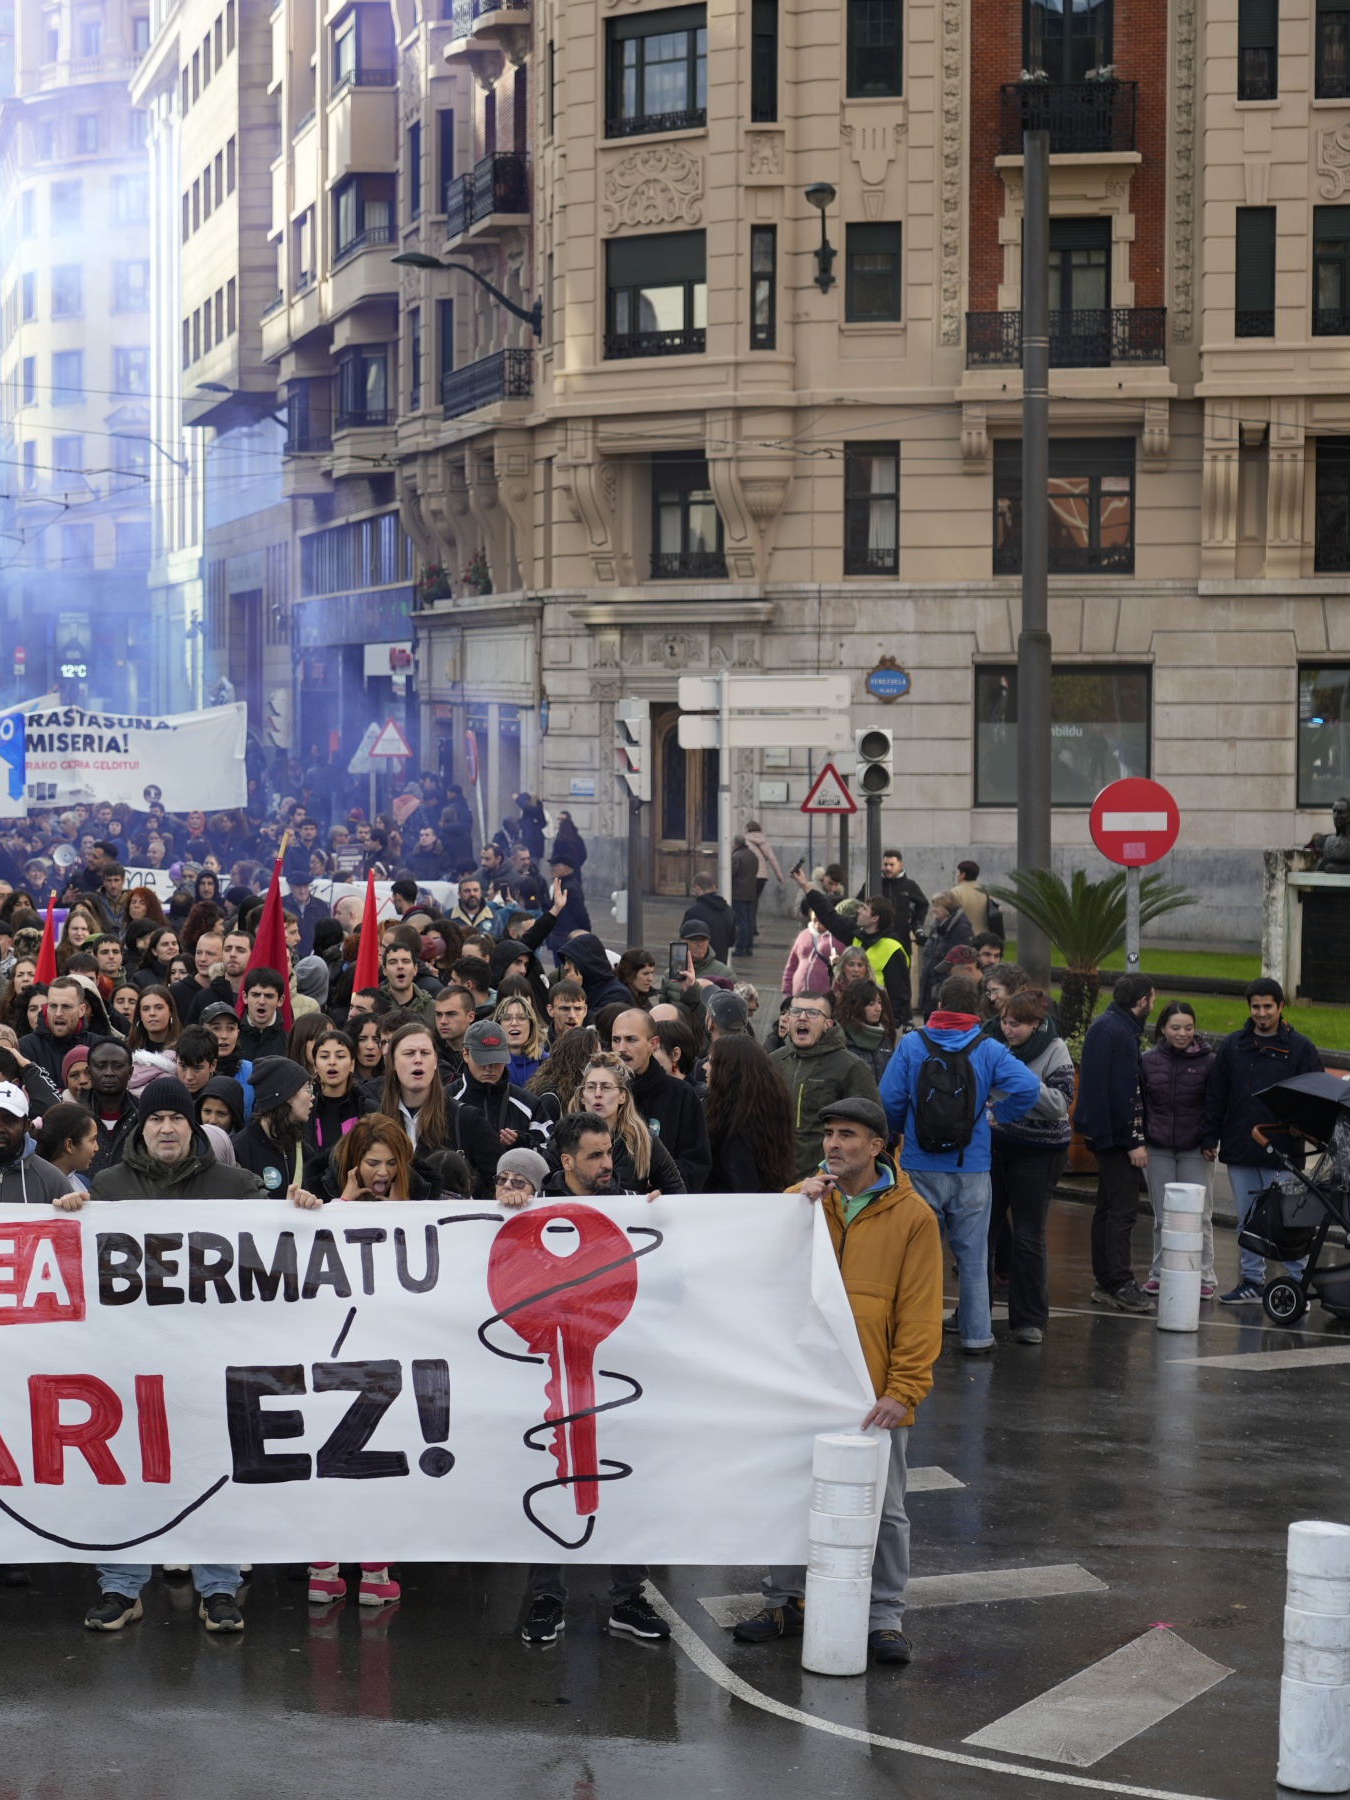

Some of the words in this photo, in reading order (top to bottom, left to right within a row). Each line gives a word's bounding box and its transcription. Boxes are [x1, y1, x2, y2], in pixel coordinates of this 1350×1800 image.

[870, 678, 907, 686] VENEZUELA
[20, 707, 179, 732] RASTASUNA,
[1051, 725, 1083, 738] bildu
[26, 734, 129, 753] MISERIA!
[25, 760, 57, 770] RAKO
[93, 760, 140, 770] GELDITU!
[96, 1224, 439, 1307] BERMATU
[225, 1358, 455, 1484] EZ!
